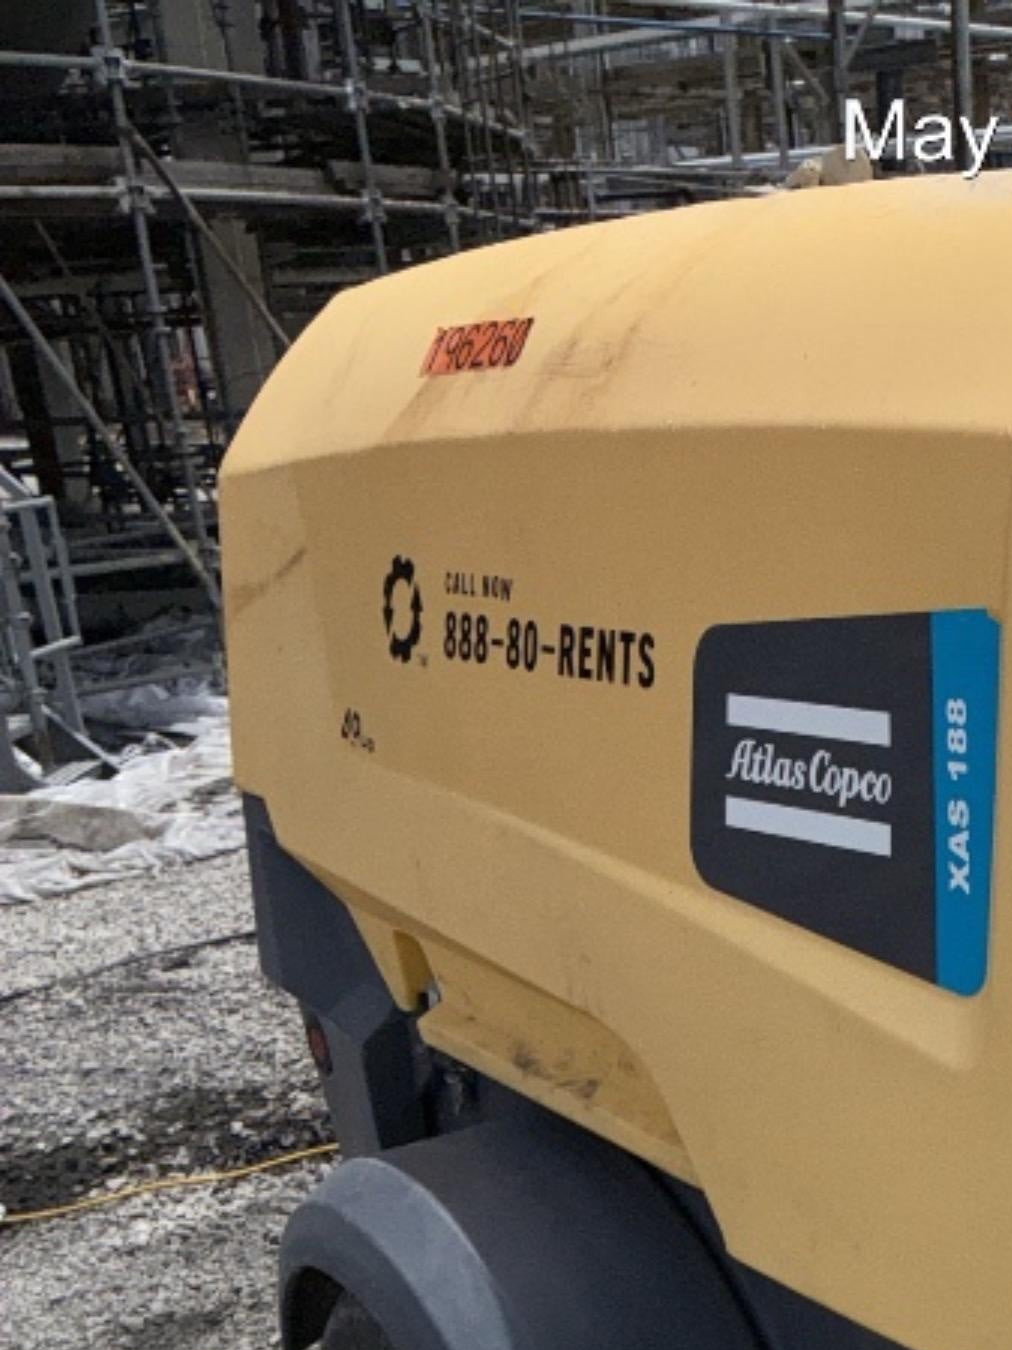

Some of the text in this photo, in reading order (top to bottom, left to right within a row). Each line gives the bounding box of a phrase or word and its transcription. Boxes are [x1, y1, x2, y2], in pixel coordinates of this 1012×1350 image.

[444, 571, 513, 601] CALL NOW
[443, 611, 655, 688] 888-80-RENTS
[725, 738, 892, 808] Atlas Copco
[946, 697, 971, 895] XAS 188
